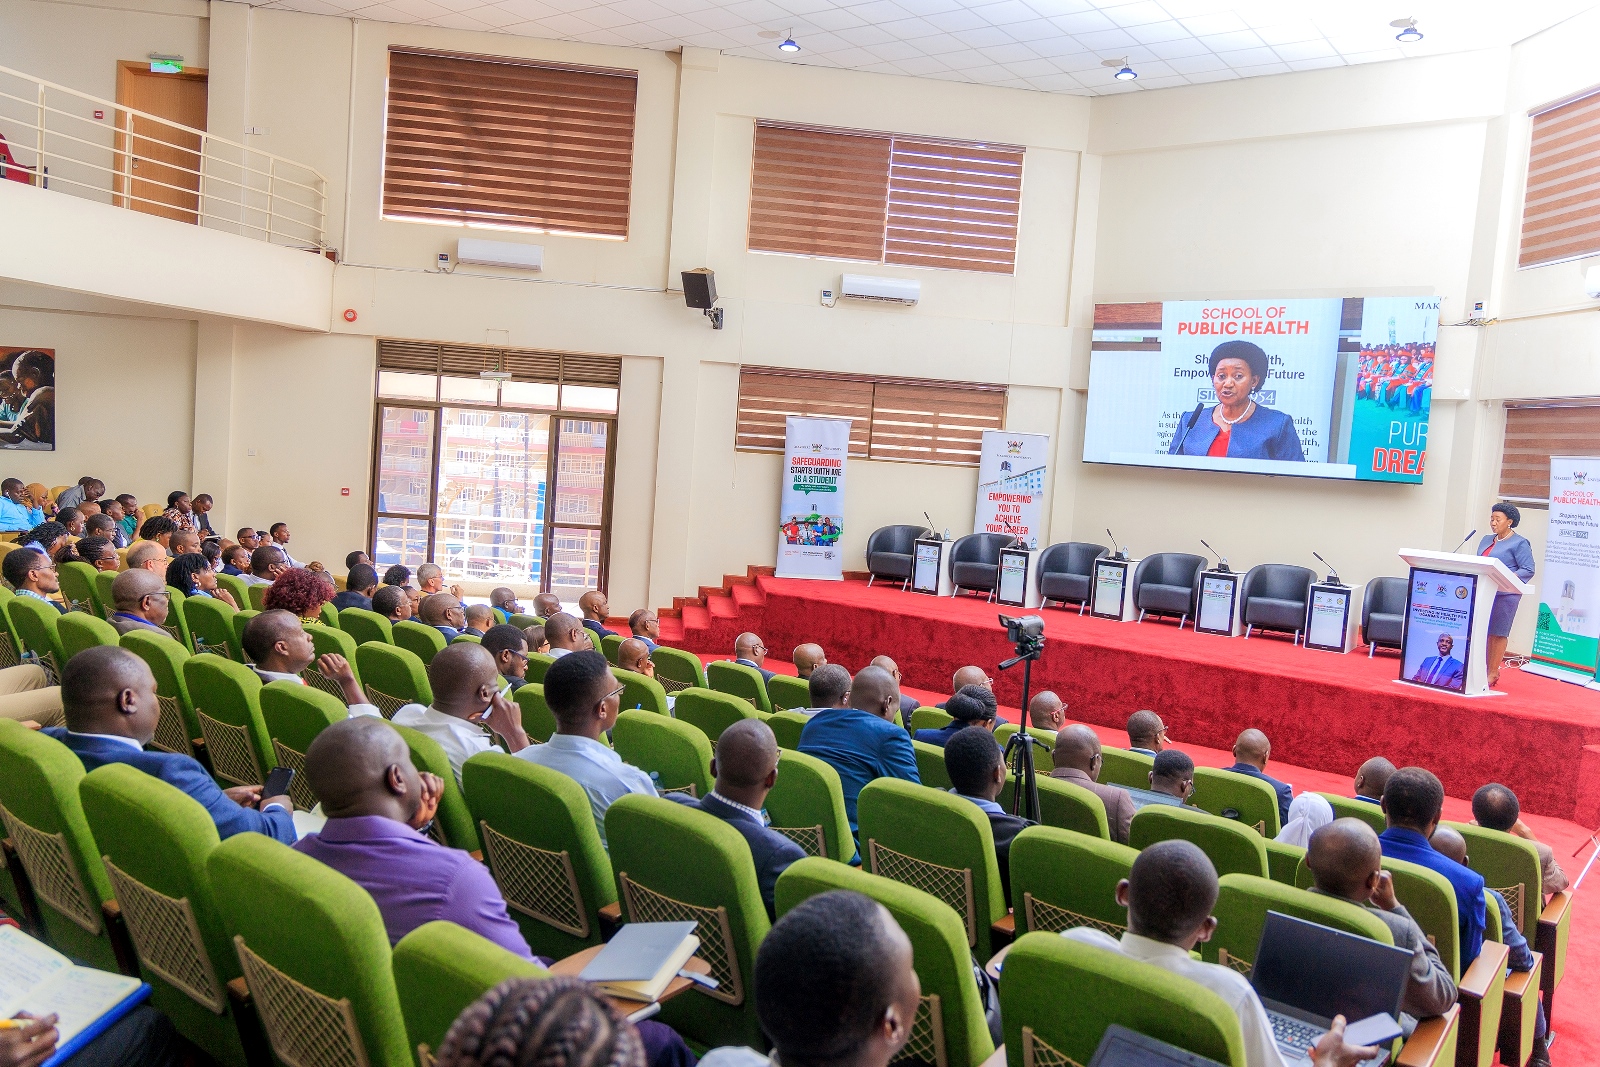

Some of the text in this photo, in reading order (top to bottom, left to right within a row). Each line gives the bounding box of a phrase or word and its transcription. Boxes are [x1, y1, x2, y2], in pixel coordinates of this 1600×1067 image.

[1201, 306, 1287, 320] SCHOOL OF
[1177, 320, 1309, 335] PUBLIC HEALTH
[1268, 354, 1285, 367] lth,
[1268, 368, 1305, 380] Future
[1249, 391, 1275, 404] 954
[1172, 411, 1181, 419] th
[1294, 416, 1313, 425] alth
[1302, 427, 1318, 436] the
[1300, 438, 1320, 447] alth,
[791, 456, 842, 468] SAFEGUARDING
[790, 466, 842, 477] STARTS WITH ME
[793, 474, 838, 484] AS A STUDENT
[988, 492, 1032, 504] EMPOWERING
[1563, 490, 1586, 498] SCHOOL
[1553, 496, 1600, 506] PUBLIC HEALTH
[997, 503, 1020, 514] YOU TO
[994, 513, 1022, 524] ACHIEVE
[1559, 512, 1577, 520] Shaping
[1550, 518, 1577, 527] Empowering
[985, 523, 1029, 535] YOUR CAREER
